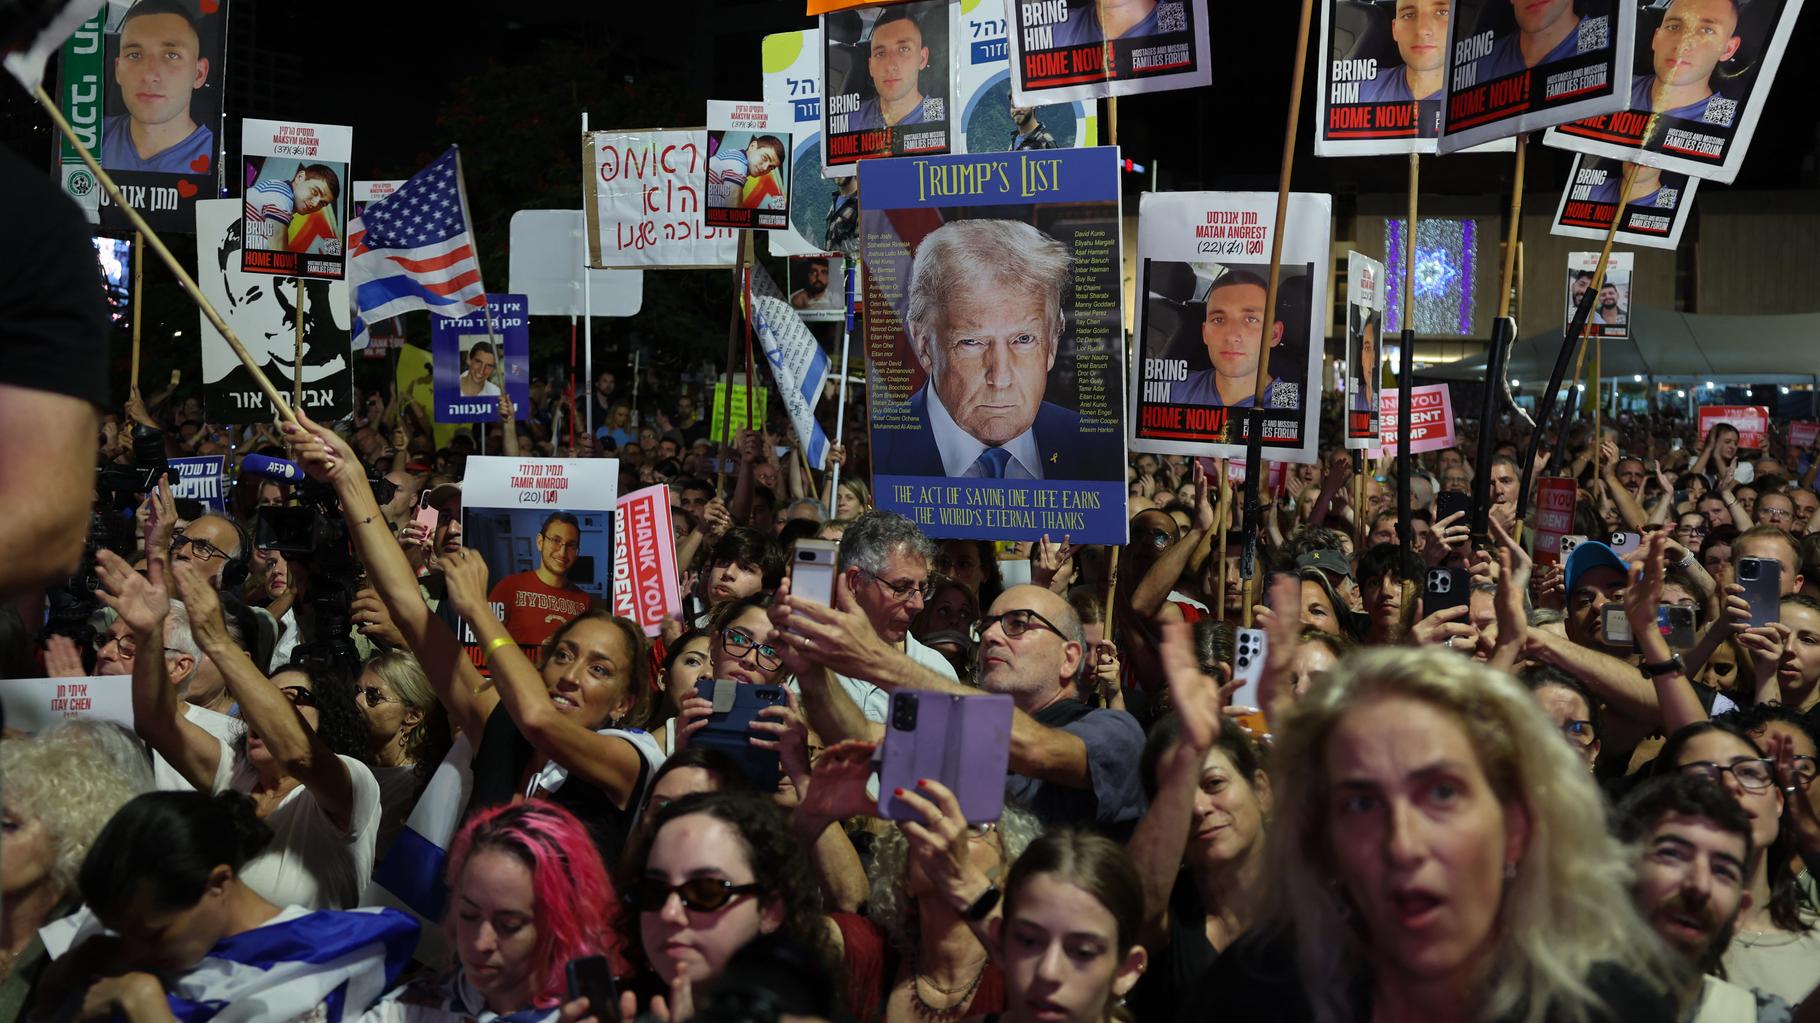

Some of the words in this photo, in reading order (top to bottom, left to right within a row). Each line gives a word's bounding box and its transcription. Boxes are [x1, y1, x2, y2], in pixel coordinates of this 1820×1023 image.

[1021, 0, 1068, 26] BRING
[1024, 25, 1054, 51] HIM
[1455, 30, 1494, 65] BRING
[1132, 48, 1156, 58] HOSTAGES
[1168, 42, 1189, 53] MISSING
[1132, 54, 1163, 70] FAMILIES
[1164, 50, 1190, 65] FORUM
[1025, 50, 1070, 78] HOME
[1332, 58, 1377, 81] BRING
[1548, 71, 1573, 85] HOSTAGES
[1573, 68, 1584, 79] AND
[1584, 63, 1608, 76] MISSING
[1453, 62, 1477, 92] HIM
[1546, 77, 1579, 97] FAMILIES
[1580, 71, 1608, 91] FORUM
[1331, 82, 1360, 104] HIM
[1451, 87, 1487, 121] HOME
[1489, 70, 1531, 108] NOW!
[829, 93, 860, 116] BRING
[1330, 106, 1373, 128] HOME
[1375, 100, 1419, 127] NOW!
[829, 115, 849, 134] HIM
[272, 135, 298, 146] MAKSYM
[298, 137, 320, 147] HARKIN
[829, 135, 858, 156] HOME
[861, 128, 892, 152] NOW!
[903, 139, 926, 150] FAMILIES
[927, 136, 946, 147] FORUM
[1663, 135, 1694, 151] FAMILIES
[1695, 142, 1723, 157] FORUM
[1667, 128, 1692, 140] HOSTAGES
[1691, 132, 1704, 142] AND
[1703, 134, 1726, 146] MISSING
[600, 142, 706, 182] ראמפ
[1020, 155, 1063, 197] LIST
[1575, 168, 1607, 186] BRING
[151, 187, 178, 211] מתן
[1570, 183, 1593, 201] HIM
[1206, 211, 1239, 225] אנגרסט
[1241, 211, 1258, 225] מתן
[1565, 201, 1594, 218] HOME
[246, 220, 274, 237] BRING
[1195, 225, 1226, 239] MATAN
[1227, 226, 1268, 240] ANGREST
[245, 251, 271, 267] HOME
[503, 302, 521, 314] אין
[502, 317, 522, 329] סגן
[1144, 357, 1188, 381] BRING
[229, 391, 263, 409] אור
[1143, 381, 1171, 404] HIM
[1142, 404, 1183, 430] HOME
[1185, 406, 1228, 432] NOW!
[1273, 427, 1298, 439] FORUM
[266, 461, 286, 475] AFP
[511, 476, 535, 489] TAMIR
[535, 477, 569, 490] NIMRODI
[519, 490, 542, 504] (20)
[892, 485, 915, 503] THE
[920, 487, 943, 504] ACT
[946, 487, 962, 504] OF
[965, 487, 1005, 509] SAVING
[1033, 490, 1059, 509] LIFE
[1062, 490, 1102, 510] EARNS
[912, 506, 936, 526] THE
[986, 509, 1038, 529] ETERNAL
[1040, 511, 1087, 531] THANKS
[634, 499, 658, 572] THANK
[642, 572, 666, 622] YOU
